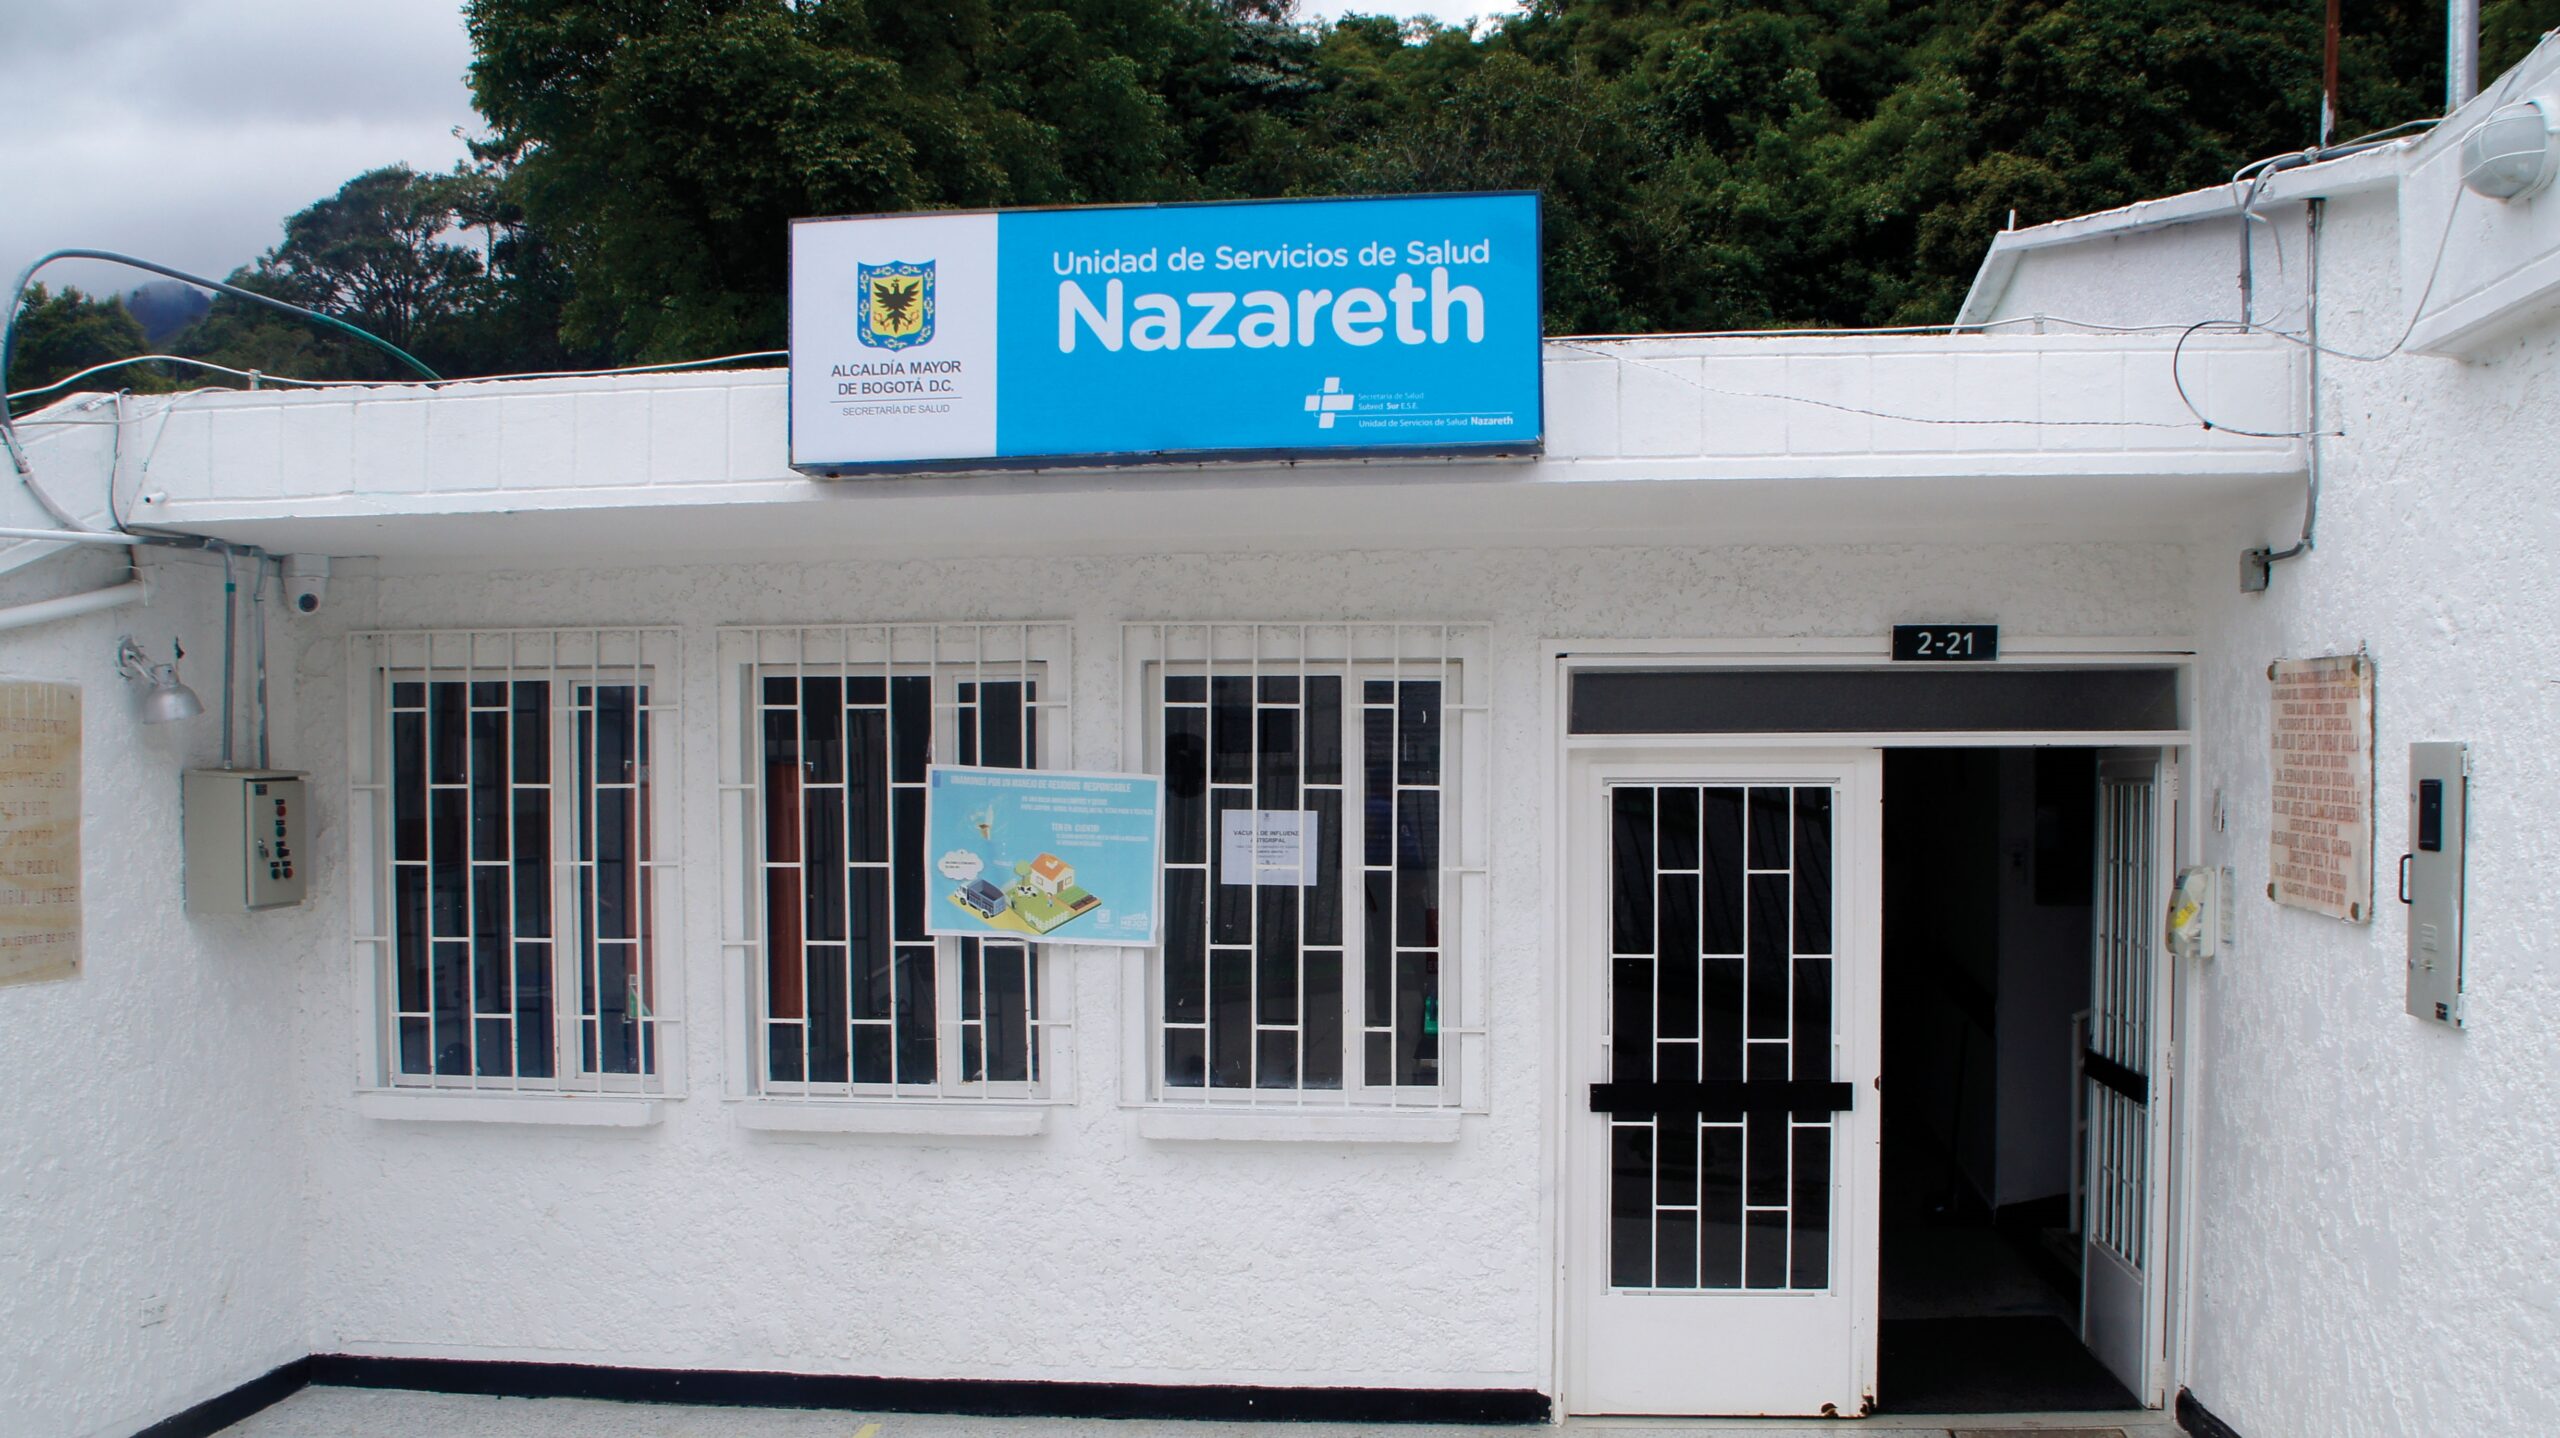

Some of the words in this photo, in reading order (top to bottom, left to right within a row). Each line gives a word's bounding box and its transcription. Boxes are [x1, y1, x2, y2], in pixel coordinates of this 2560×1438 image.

[1053, 247, 1158, 276] Unidad
[1168, 246, 1205, 271] de
[1215, 243, 1349, 271] Servicios
[1358, 241, 1397, 267] de
[1406, 238, 1490, 265] Salud
[1058, 266, 1486, 354] Nazareth
[831, 359, 905, 378] ALCALDÍA
[910, 360, 962, 375] MAYOR
[838, 382, 857, 395] DE
[862, 377, 924, 395] BOGOTÁ
[929, 379, 954, 393] D.C.
[1404, 392, 1425, 400] Salud
[842, 403, 900, 417] SECRETARÍA
[903, 404, 917, 415] DE
[918, 404, 950, 414] SALUD
[1358, 402, 1384, 411] Subred
[1386, 402, 1400, 410] Sur
[1359, 419, 1387, 428] Unidad
[1388, 418, 1398, 427] de
[1400, 418, 1433, 427] Servicios
[1435, 417, 1445, 426] de
[1446, 417, 1468, 426] Salud
[1470, 416, 1514, 426] Nazareth
[1917, 631, 1974, 655] 2-21
